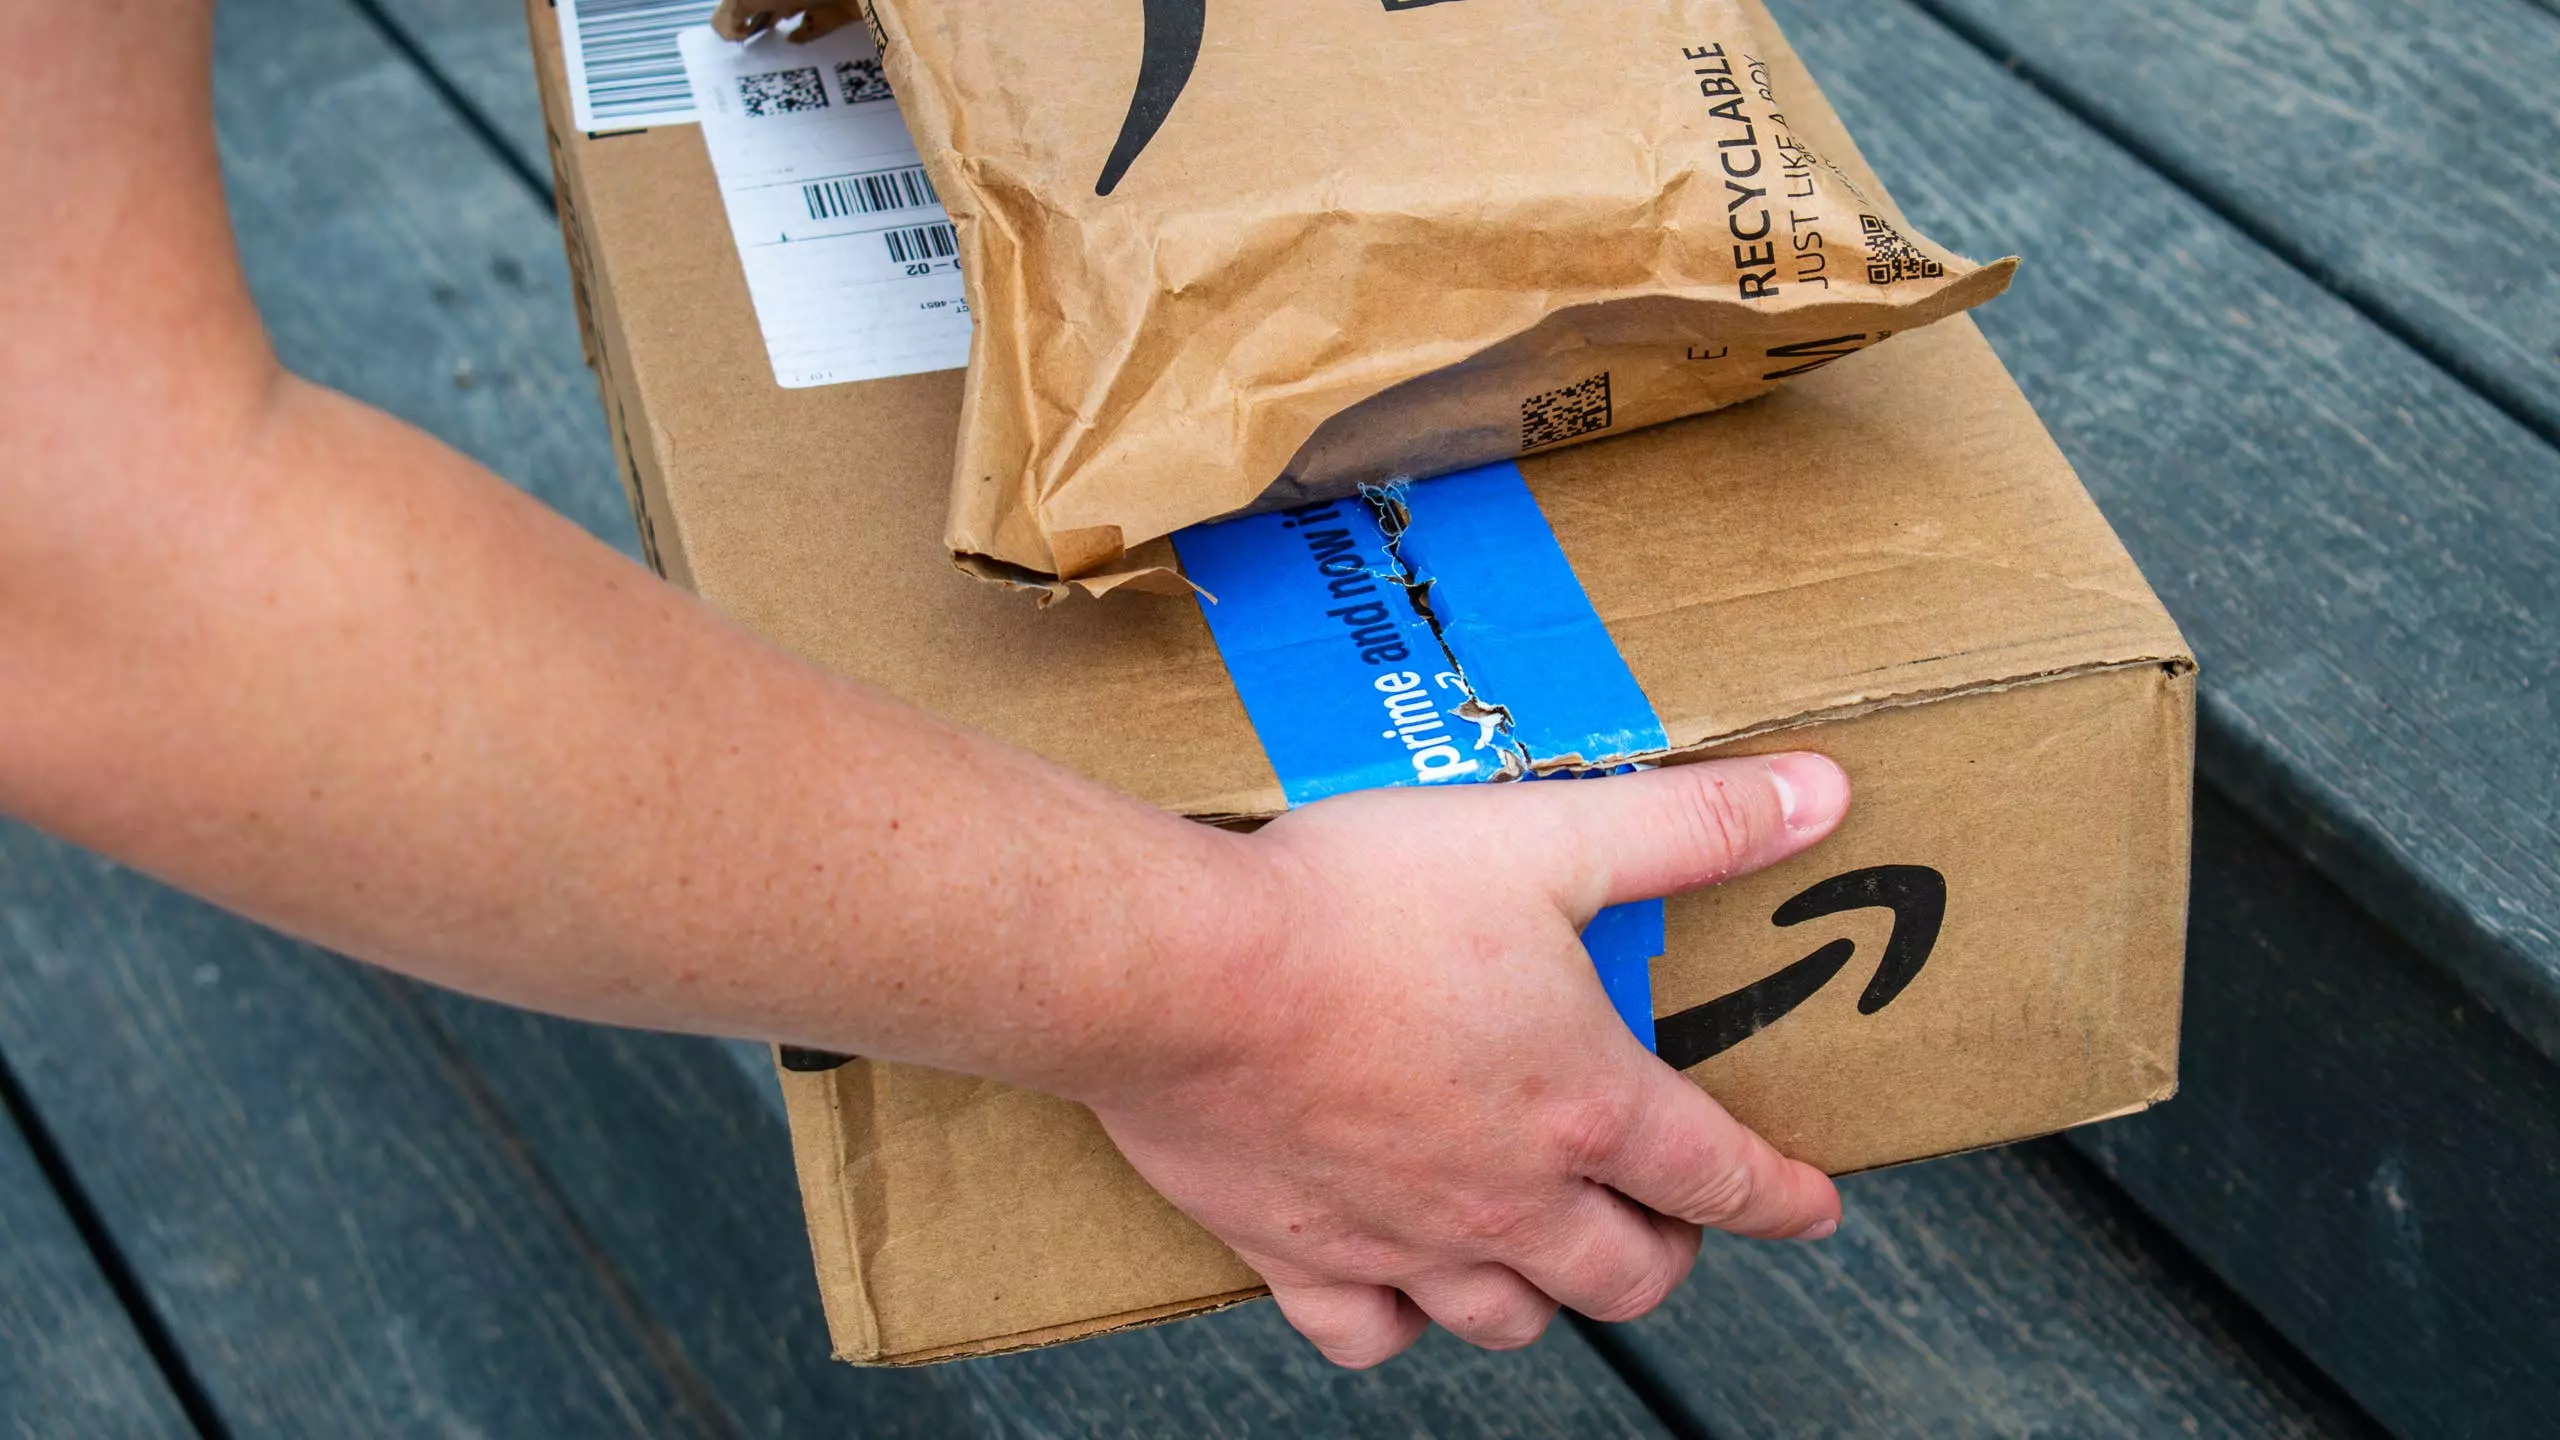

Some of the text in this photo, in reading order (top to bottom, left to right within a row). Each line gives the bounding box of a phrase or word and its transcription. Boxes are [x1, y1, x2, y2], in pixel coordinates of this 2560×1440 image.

[1768, 112, 1790, 129] A
[1682, 42, 1779, 300] RECYCLABLE
[1775, 133, 1814, 198] LIKE
[1790, 209, 1829, 289] JUST
[1687, 345, 1728, 361] E
[1304, 528, 1378, 601] now
[1326, 599, 1411, 665] and
[1374, 670, 1478, 783] prime
